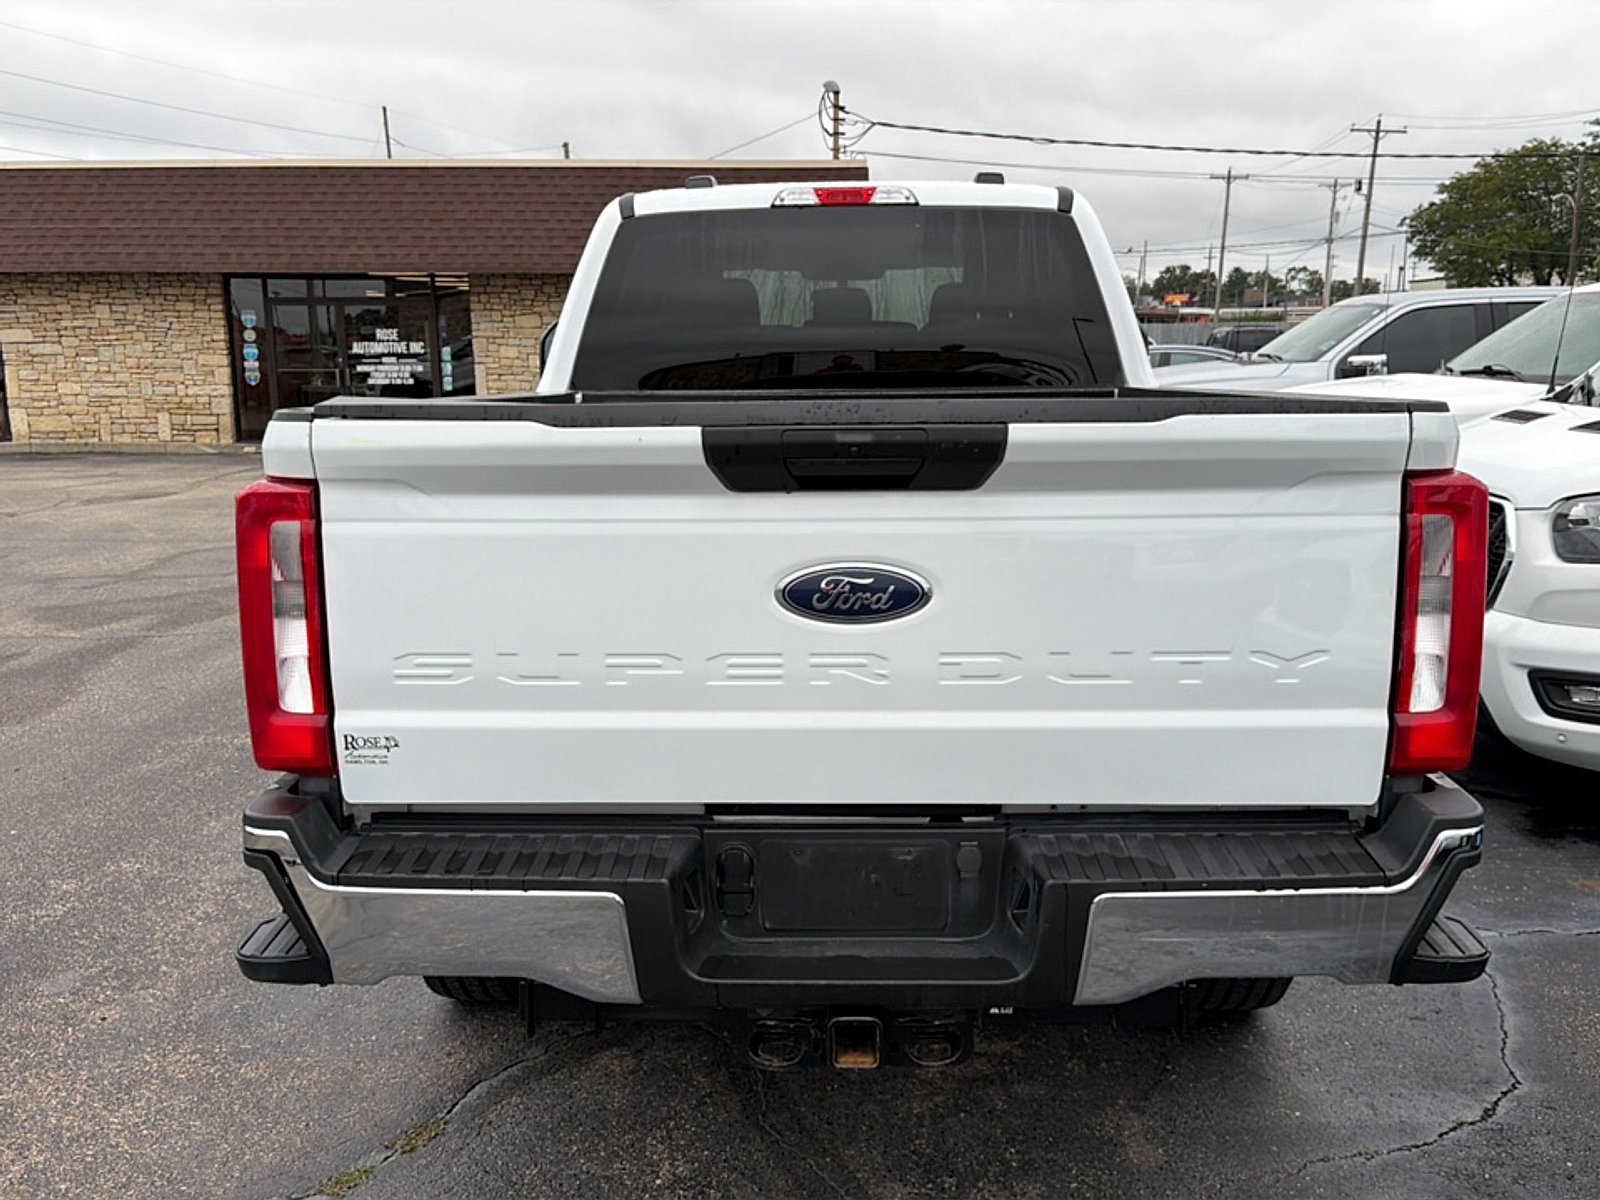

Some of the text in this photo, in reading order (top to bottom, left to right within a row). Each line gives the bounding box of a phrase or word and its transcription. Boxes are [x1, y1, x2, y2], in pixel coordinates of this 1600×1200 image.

[375, 328, 400, 341] ROSE
[352, 341, 425, 354] AUTOMOTIVE INC
[812, 575, 896, 611] Ford
[393, 649, 1331, 686] SUPER DUTY
